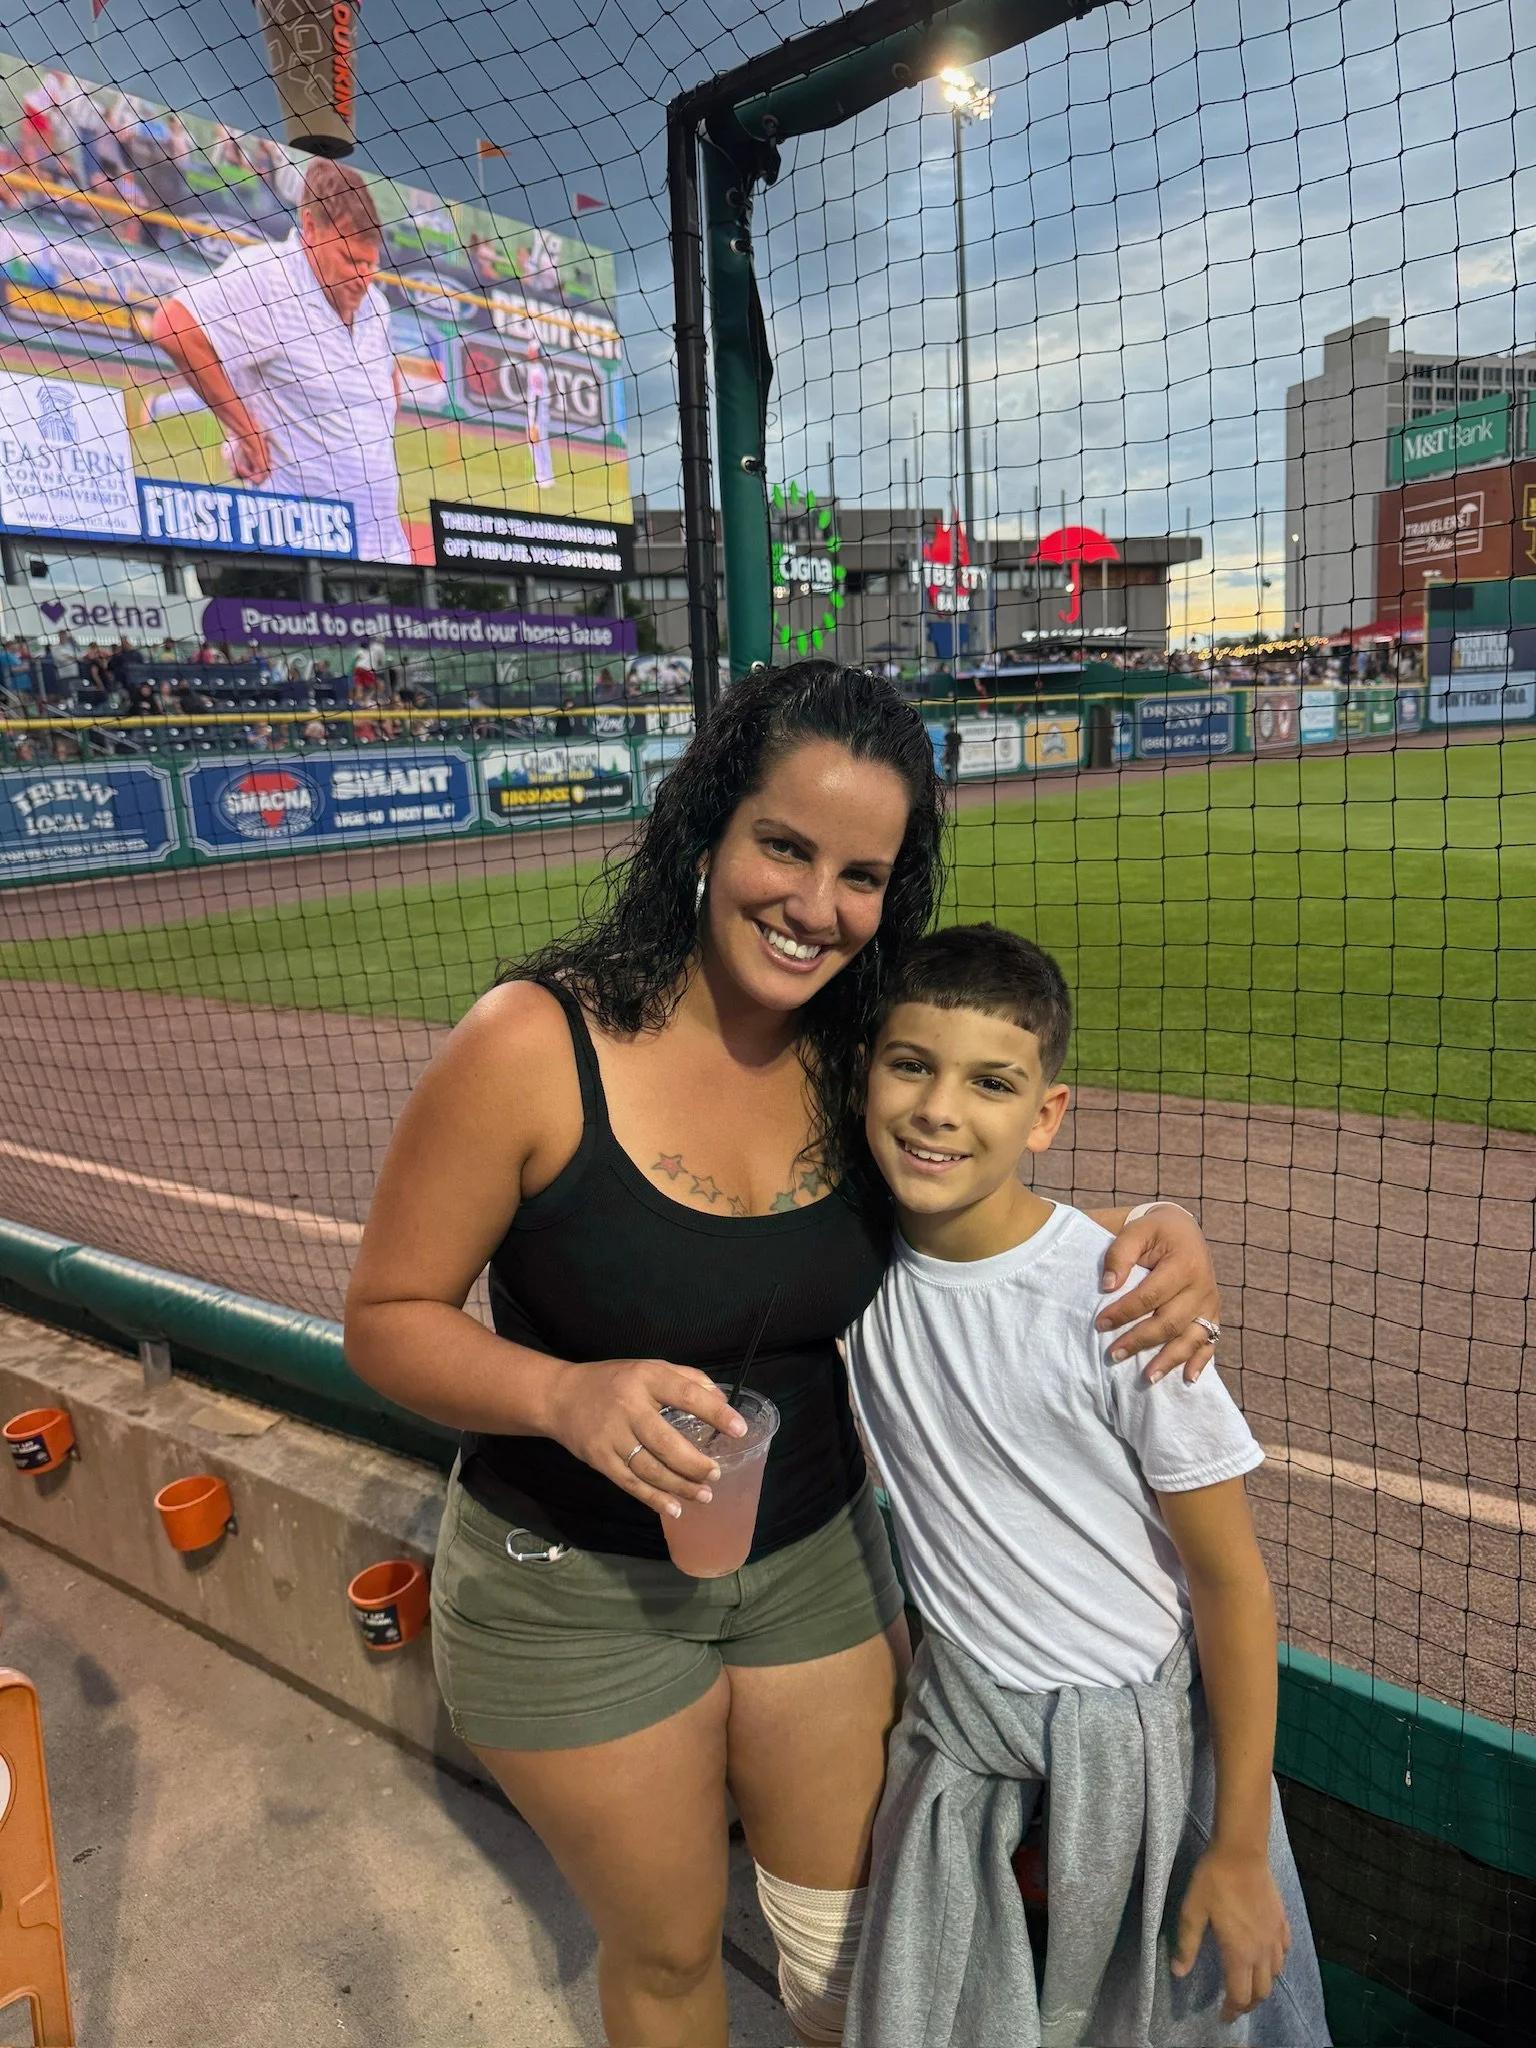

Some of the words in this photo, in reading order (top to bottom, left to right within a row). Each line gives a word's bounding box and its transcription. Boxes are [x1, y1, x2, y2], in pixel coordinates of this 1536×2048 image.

[1404, 428, 1448, 463] M&T
[1449, 417, 1494, 450] Bank
[142, 485, 233, 543] FIRST
[236, 494, 353, 553] PITCHES
[71, 602, 162, 628] aetna
[241, 607, 320, 636] Proud
[321, 612, 348, 637] to
[351, 613, 393, 638] call
[394, 614, 484, 642] Hartford
[486, 622, 517, 643] our
[520, 620, 570, 645] home
[571, 621, 612, 646] base
[1142, 701, 1227, 718] DRESSLER
[1165, 717, 1204, 730] LAW
[331, 765, 452, 799] SMART
[226, 787, 311, 814] SMACNA
